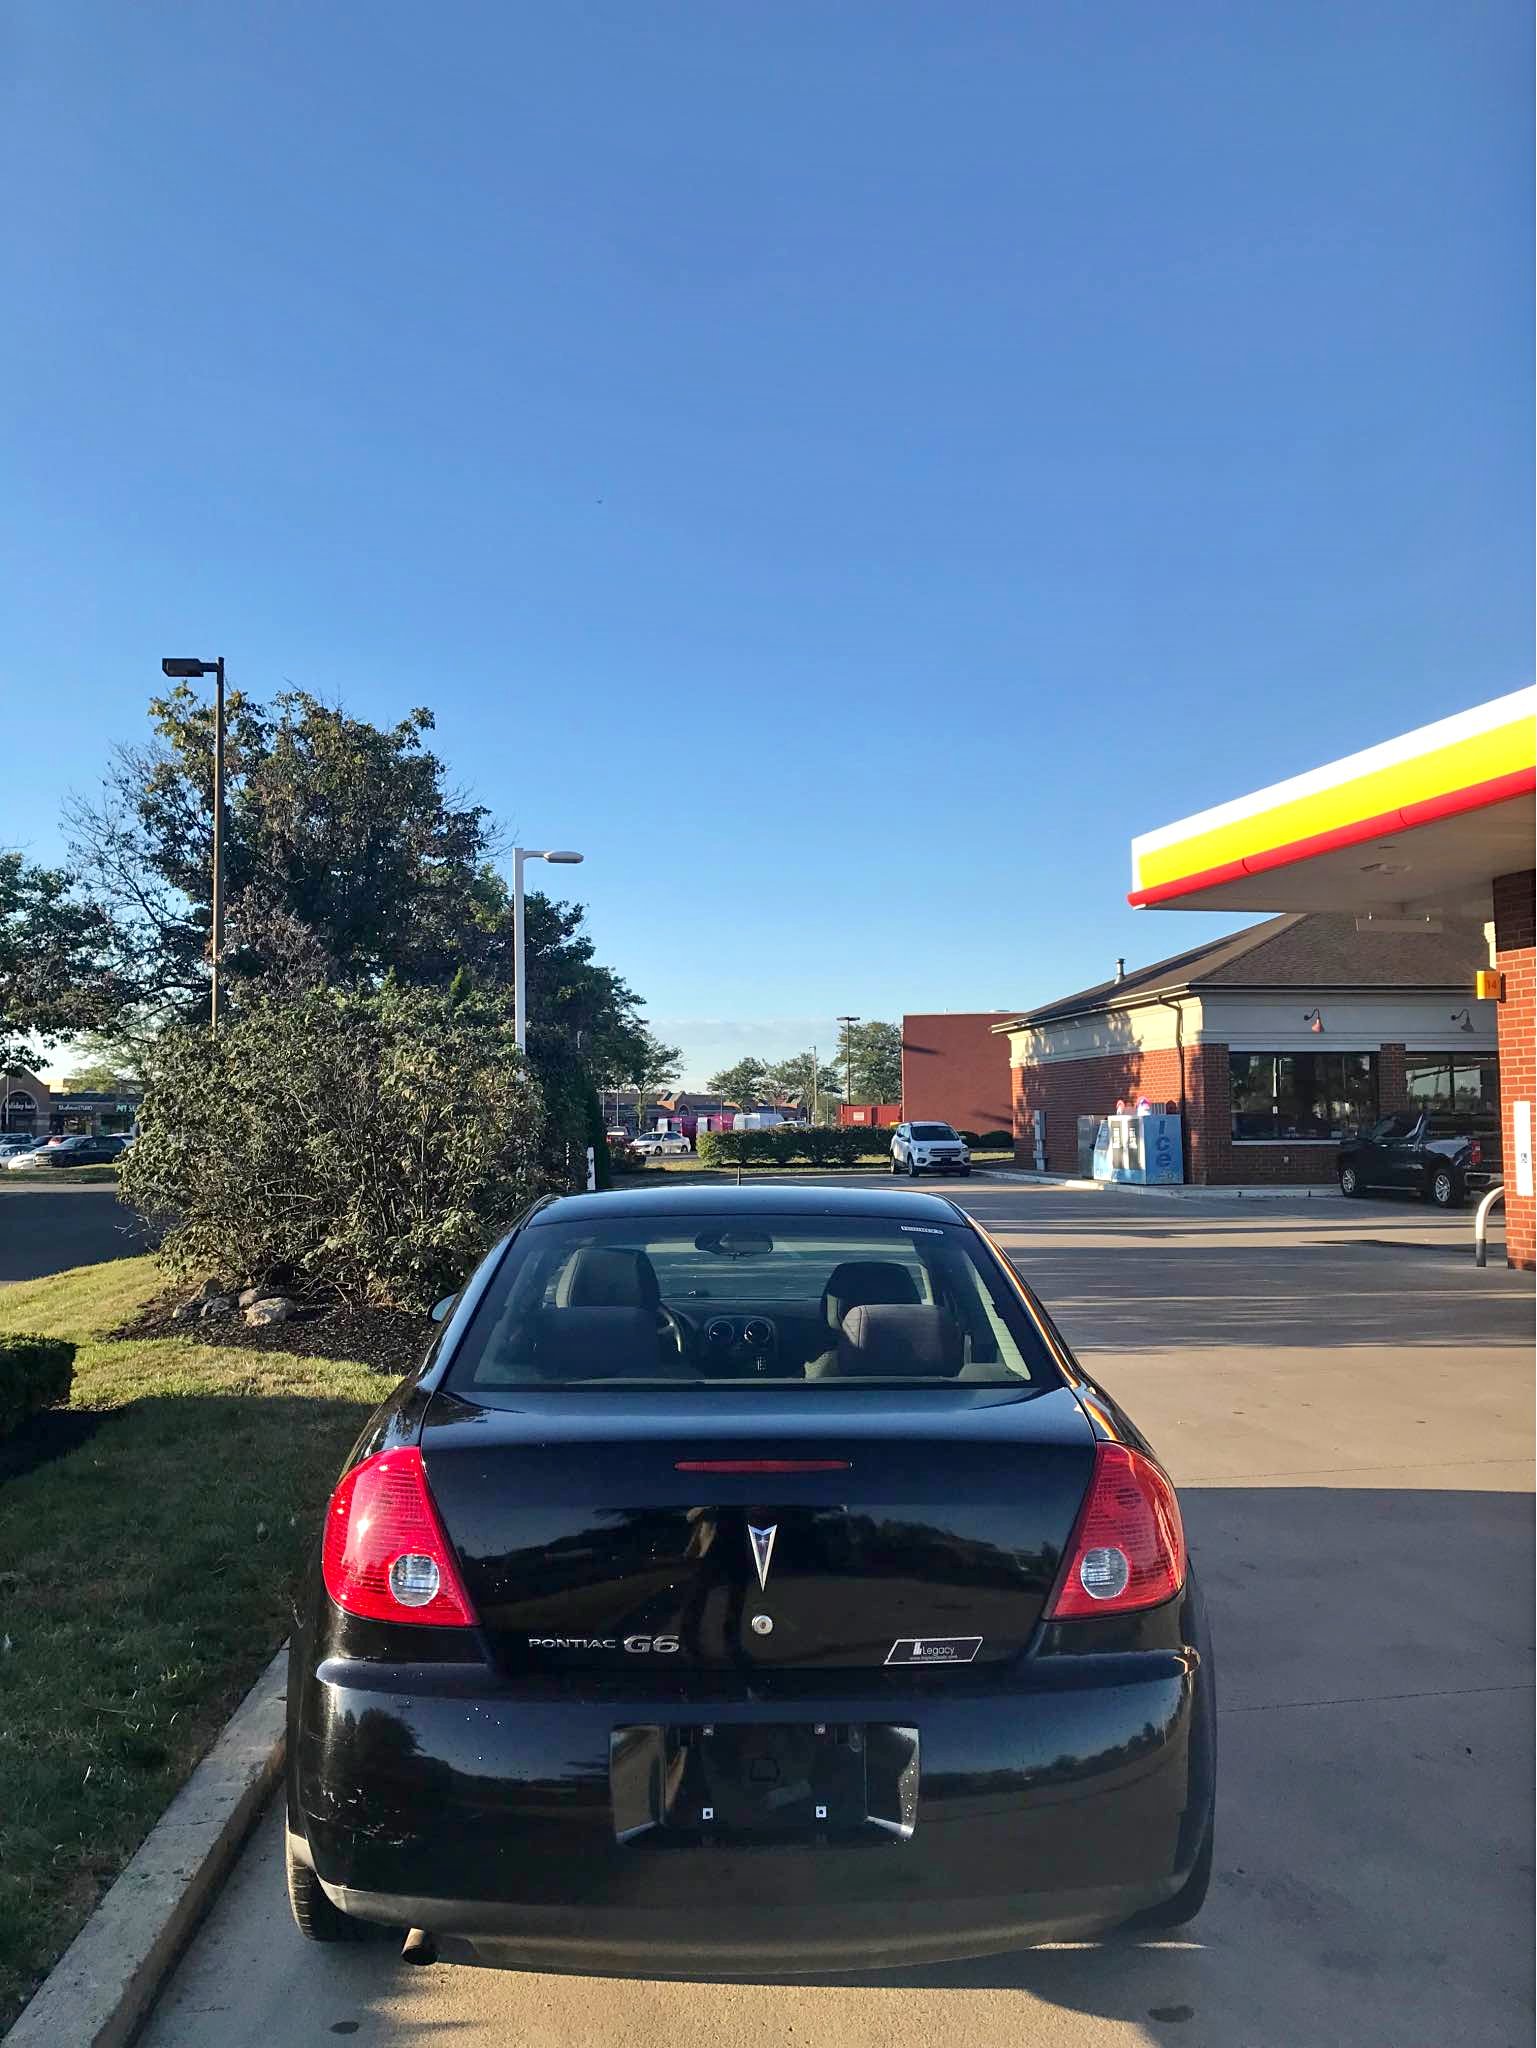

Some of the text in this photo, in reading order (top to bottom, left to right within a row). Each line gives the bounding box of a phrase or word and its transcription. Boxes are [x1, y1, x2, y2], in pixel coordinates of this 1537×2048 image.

[528, 1635, 680, 1653] PONTIAC G6
[922, 1646, 955, 1657] Legacy
